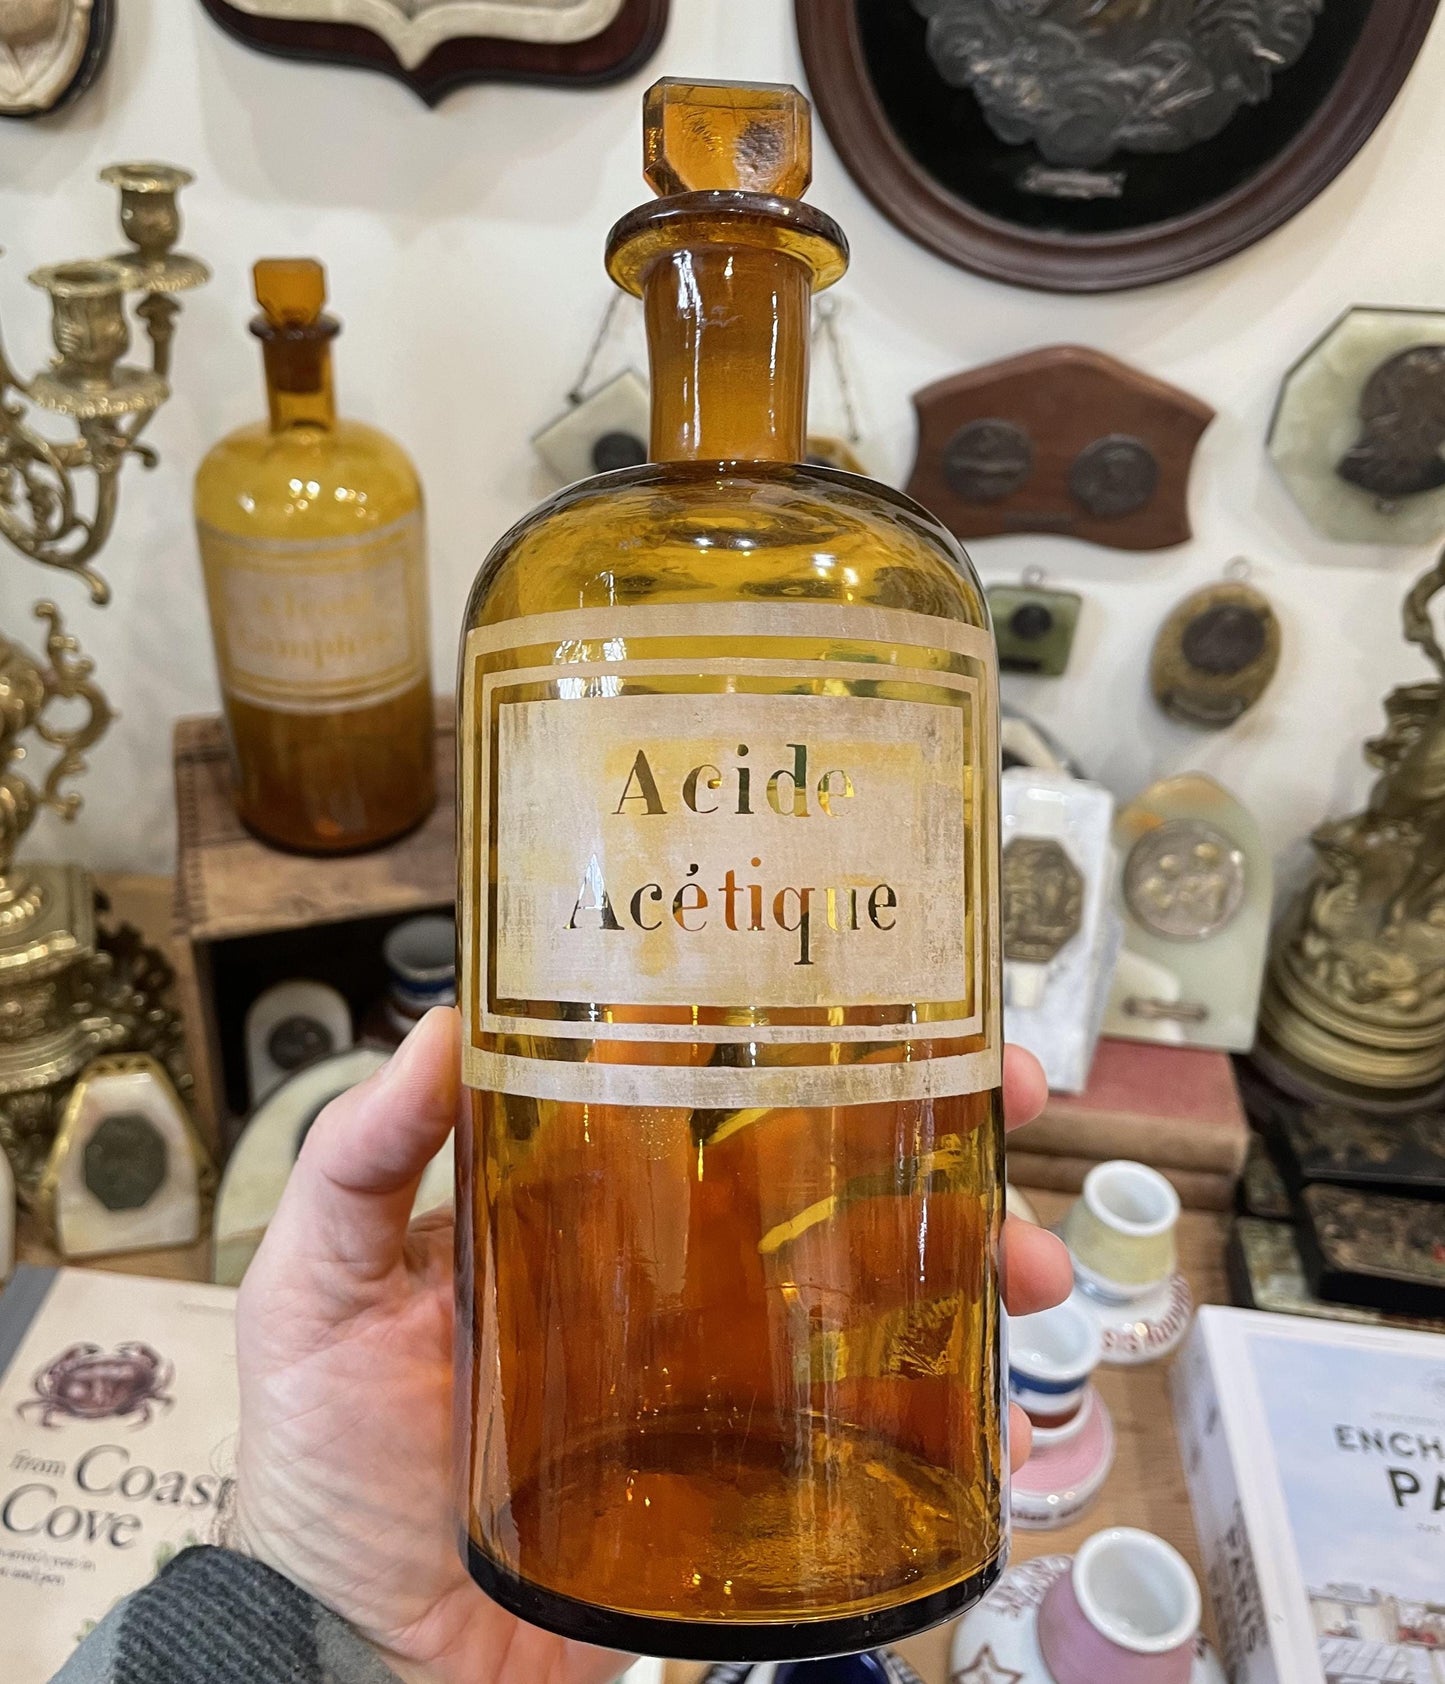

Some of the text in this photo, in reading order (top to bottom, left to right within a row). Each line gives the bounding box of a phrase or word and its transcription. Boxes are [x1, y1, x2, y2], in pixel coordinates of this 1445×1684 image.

[611, 744, 855, 817] Acide
[563, 854, 897, 965] Acétique
[2, 1483, 142, 1549] Cove
